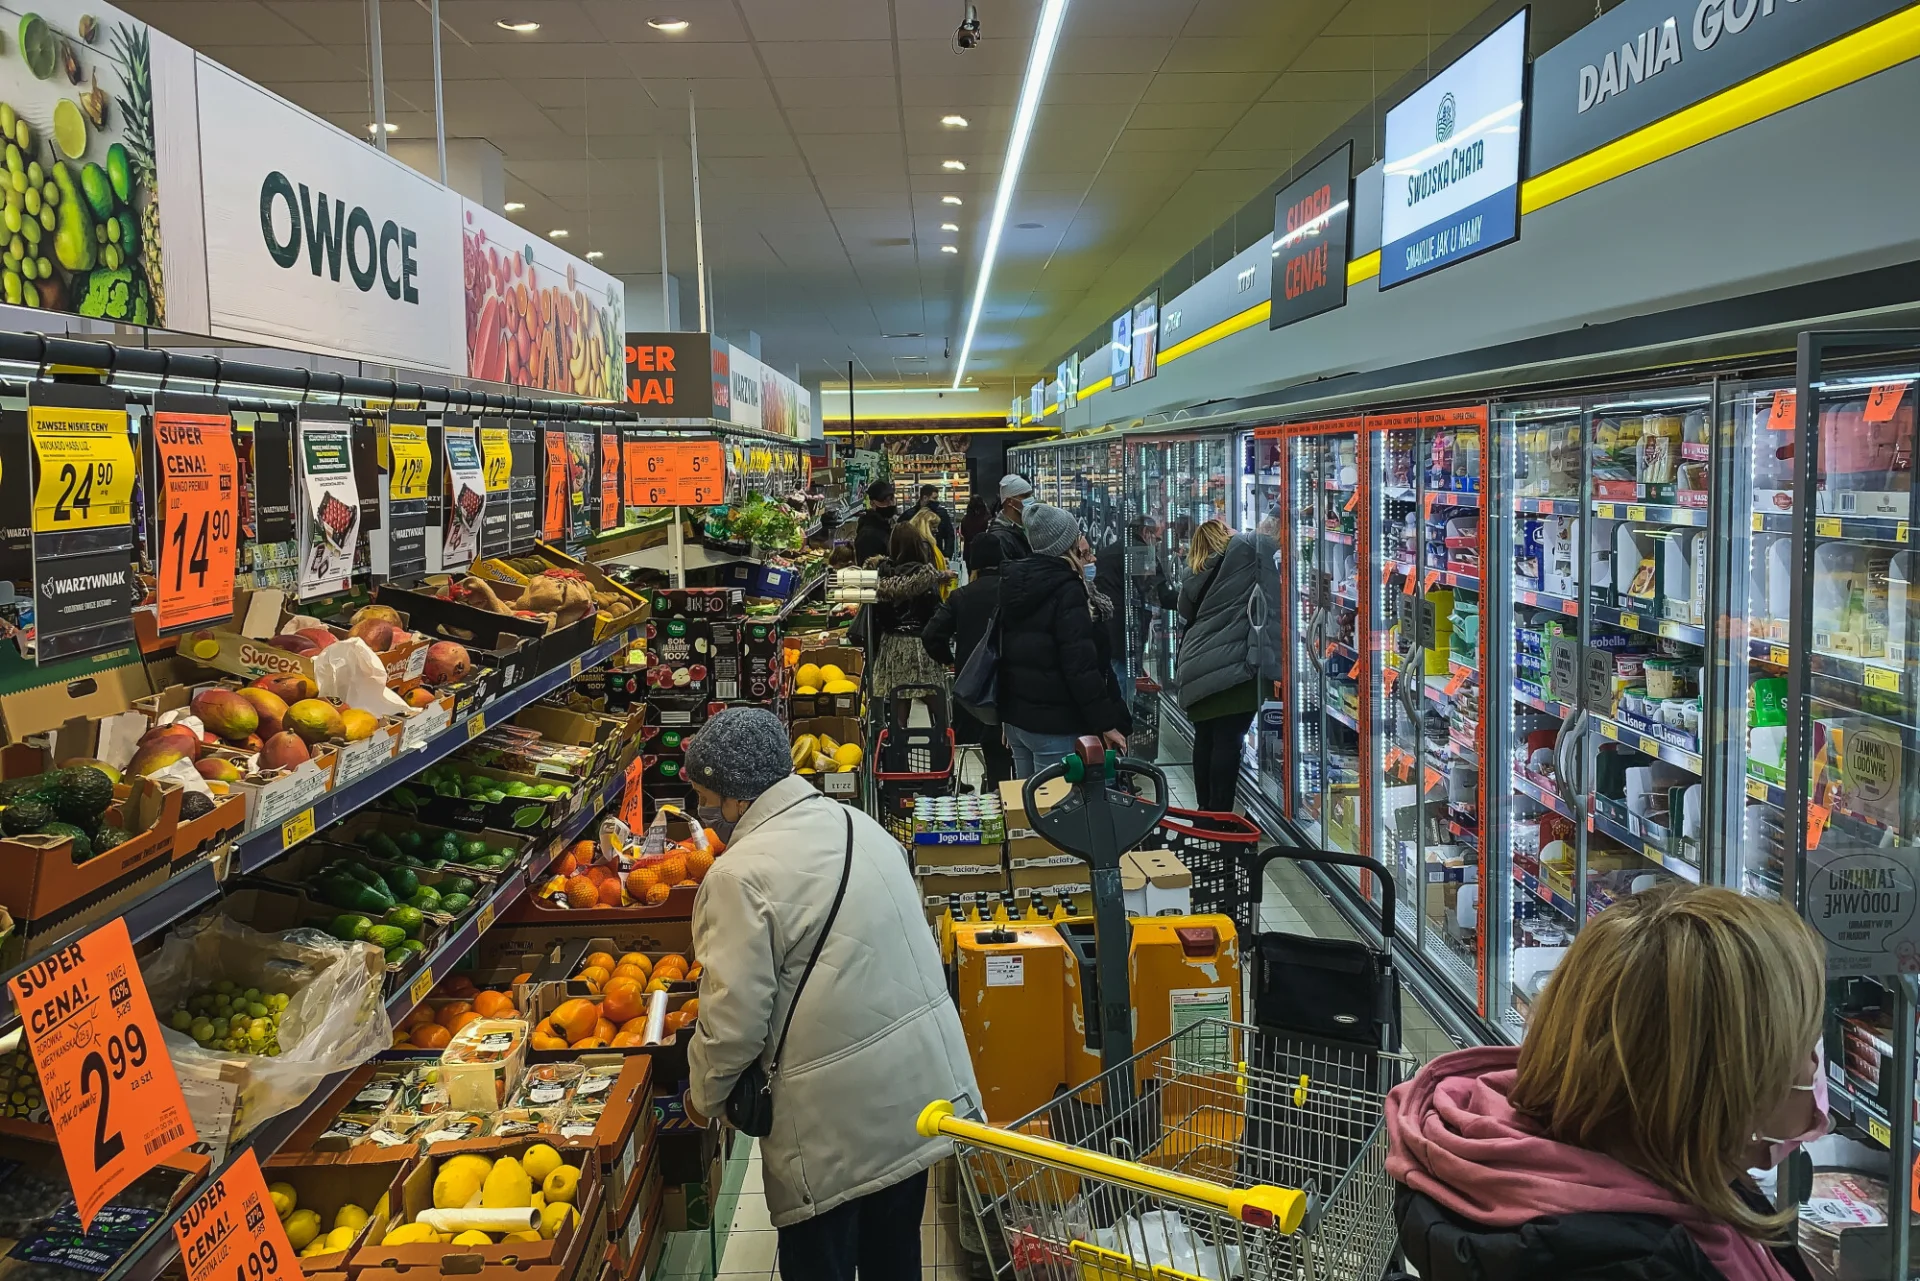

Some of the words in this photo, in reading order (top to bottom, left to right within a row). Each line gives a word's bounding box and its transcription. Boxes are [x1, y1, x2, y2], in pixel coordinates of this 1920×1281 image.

[1578, 16, 1682, 114] DANIA
[1693, 0, 1800, 51] GO
[1407, 159, 1450, 207] SWOJSKA
[1451, 139, 1484, 184] CHATA
[1285, 184, 1331, 248] SUPER
[260, 171, 419, 305] OWOCE
[1406, 236, 1435, 271] SMAKUJE
[1435, 227, 1449, 259] JAK
[1450, 225, 1456, 250] U
[1458, 215, 1483, 250] MAMY
[1285, 240, 1328, 300] CENA!
[625, 346, 676, 372] PER
[623, 378, 675, 404] NA!
[36, 421, 66, 431] ZAWSZE
[68, 421, 90, 431] NISKIE
[91, 423, 108, 431] CENY
[160, 425, 204, 445] SUPER
[167, 454, 207, 473] CENA!
[648, 457, 656, 473] 6
[693, 456, 701, 472] 5
[53, 463, 94, 521] 24
[97, 462, 113, 486] 90
[649, 488, 658, 503] 6
[695, 488, 703, 503] 5
[6, 528, 32, 538] WARZY
[173, 511, 210, 592] 14
[212, 509, 230, 541] 90
[55, 571, 126, 595] WARZYWNIAK
[1590, 635, 1626, 648] gobella
[241, 645, 301, 674] Sweet
[664, 652, 690, 660] 100%
[1866, 672, 1875, 687] 11
[1625, 714, 1647, 731] Lisner
[1661, 727, 1686, 748] Lisner
[1855, 738, 1886, 761] ZAMKNIJ
[1853, 756, 1887, 782] LODÓWKĘ
[938, 833, 959, 844] Jogo
[960, 832, 980, 841] bella
[16, 942, 86, 998] SUPER
[106, 963, 126, 984] TANIEJ
[111, 983, 130, 1003] 43%
[31, 978, 90, 1034] CENA!
[116, 1001, 132, 1021] 5,29
[130, 1080, 140, 1091] za
[141, 1070, 153, 1084] szt
[80, 1051, 125, 1173] 2
[108, 1023, 147, 1080] 99
[1871, 1123, 1880, 1138] 11
[179, 1179, 227, 1239] SUPER
[187, 1211, 231, 1268] CENA!
[248, 1240, 278, 1281] 99
